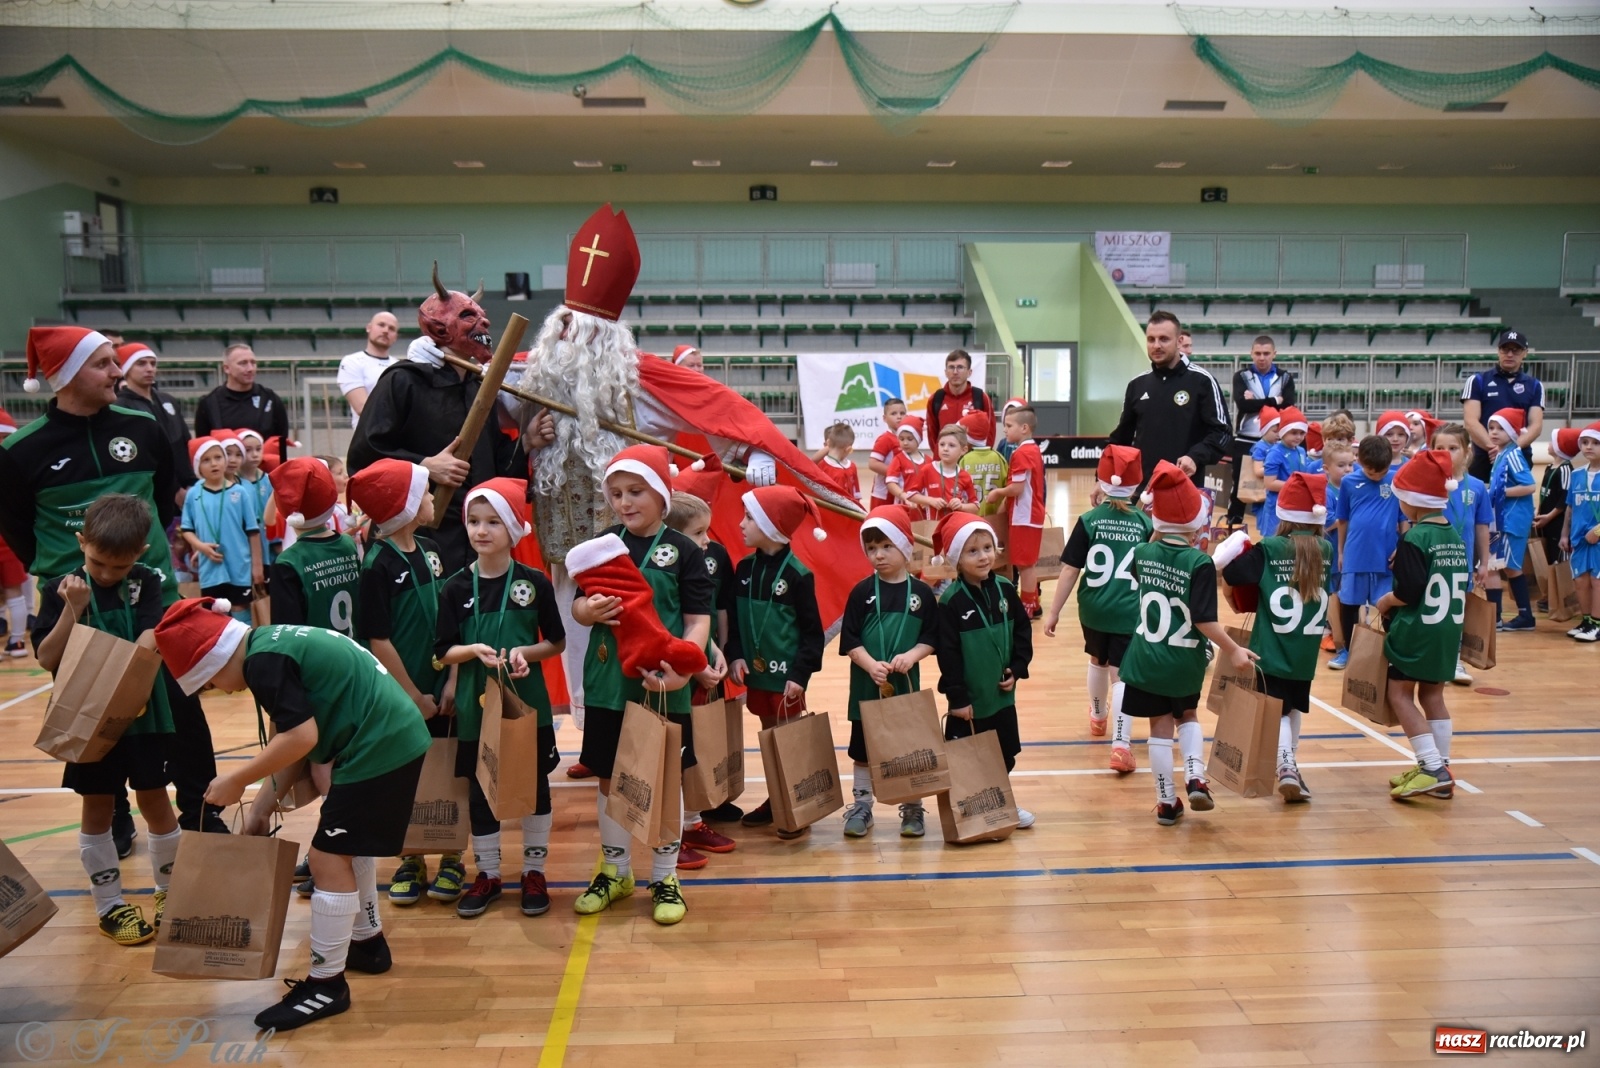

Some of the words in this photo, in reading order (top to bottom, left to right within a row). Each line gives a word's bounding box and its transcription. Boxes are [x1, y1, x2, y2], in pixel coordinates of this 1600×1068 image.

[1103, 234, 1162, 247] MIESZKO
[1071, 446, 1104, 459] ddmb
[1086, 544, 1139, 591] 94
[1140, 574, 1187, 596] TWORKÓW
[1421, 573, 1469, 625] 95
[1270, 586, 1328, 635] 92
[769, 660, 788, 674] 94
